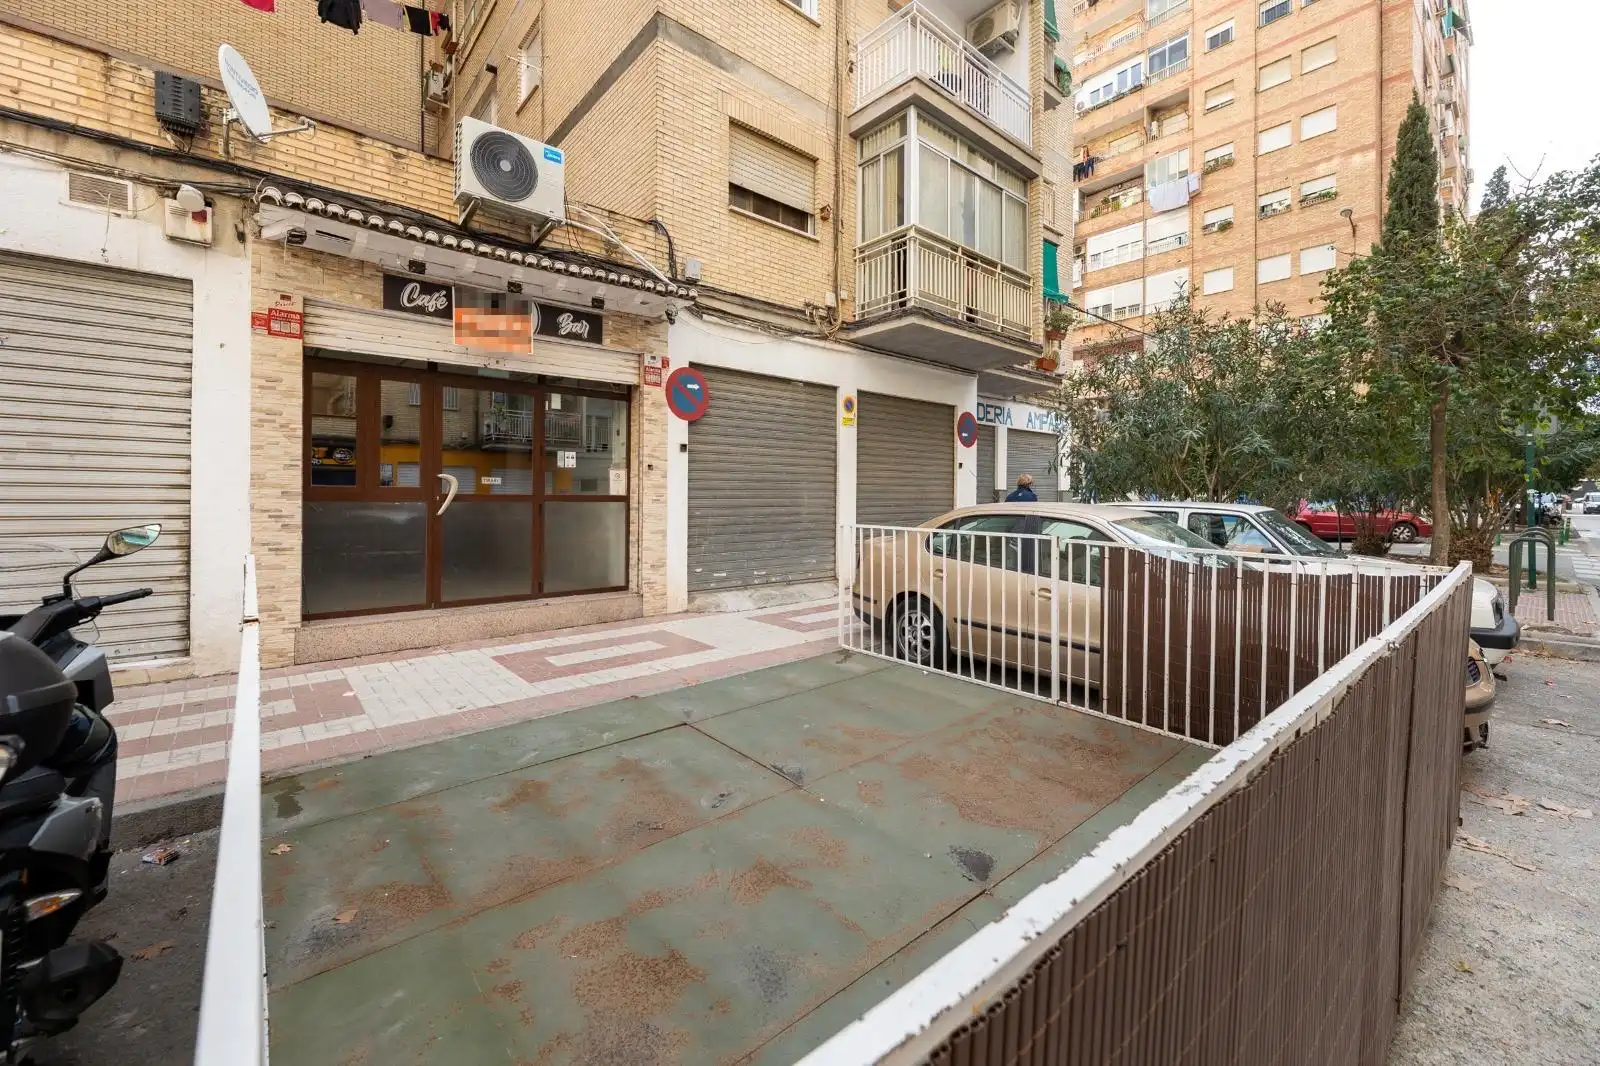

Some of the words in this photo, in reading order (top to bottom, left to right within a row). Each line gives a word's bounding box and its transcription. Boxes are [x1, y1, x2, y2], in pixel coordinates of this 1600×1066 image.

[400, 282, 449, 312] Café
[270, 309, 300, 320] Alarma
[557, 312, 590, 339] Bar
[977, 402, 1013, 426] DERIA
[1026, 411, 1063, 433] AMPA
